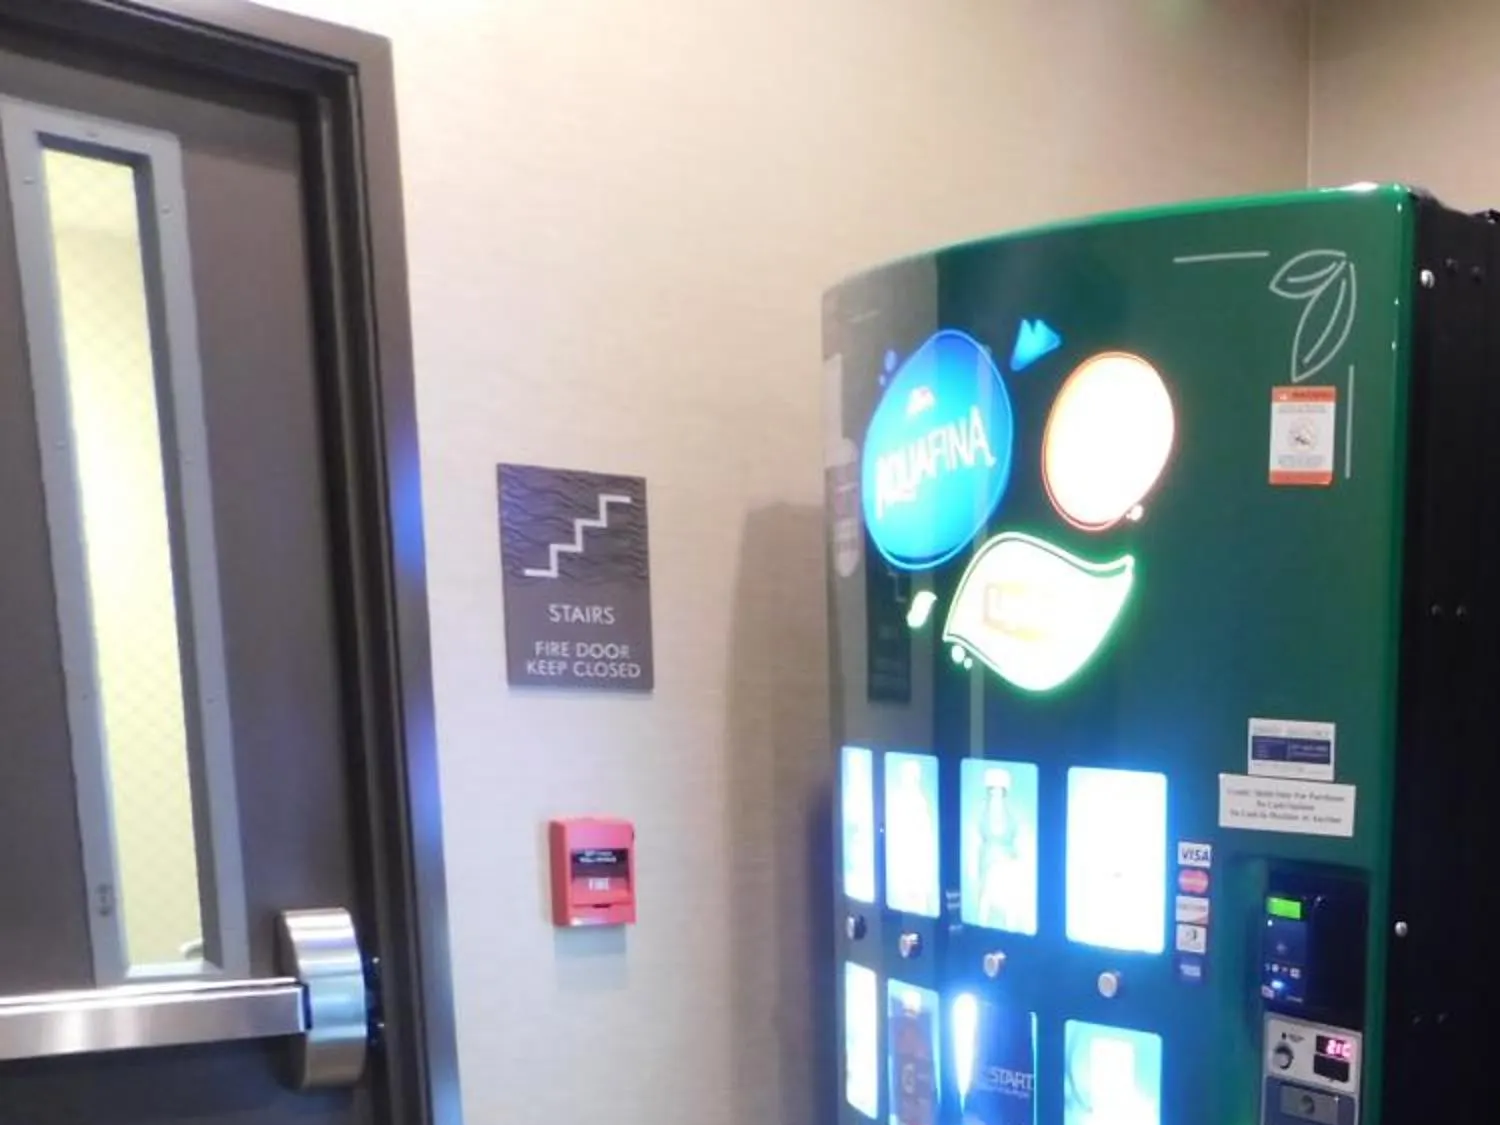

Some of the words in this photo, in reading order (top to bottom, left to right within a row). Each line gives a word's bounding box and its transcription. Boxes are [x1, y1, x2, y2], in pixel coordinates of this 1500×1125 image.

[549, 603, 616, 625] STAIRS
[534, 640, 570, 658] FIRE
[575, 641, 631, 660] DOOR
[526, 659, 568, 677] KEEP
[572, 660, 641, 679] CLOSED
[1181, 848, 1209, 861] VISA
